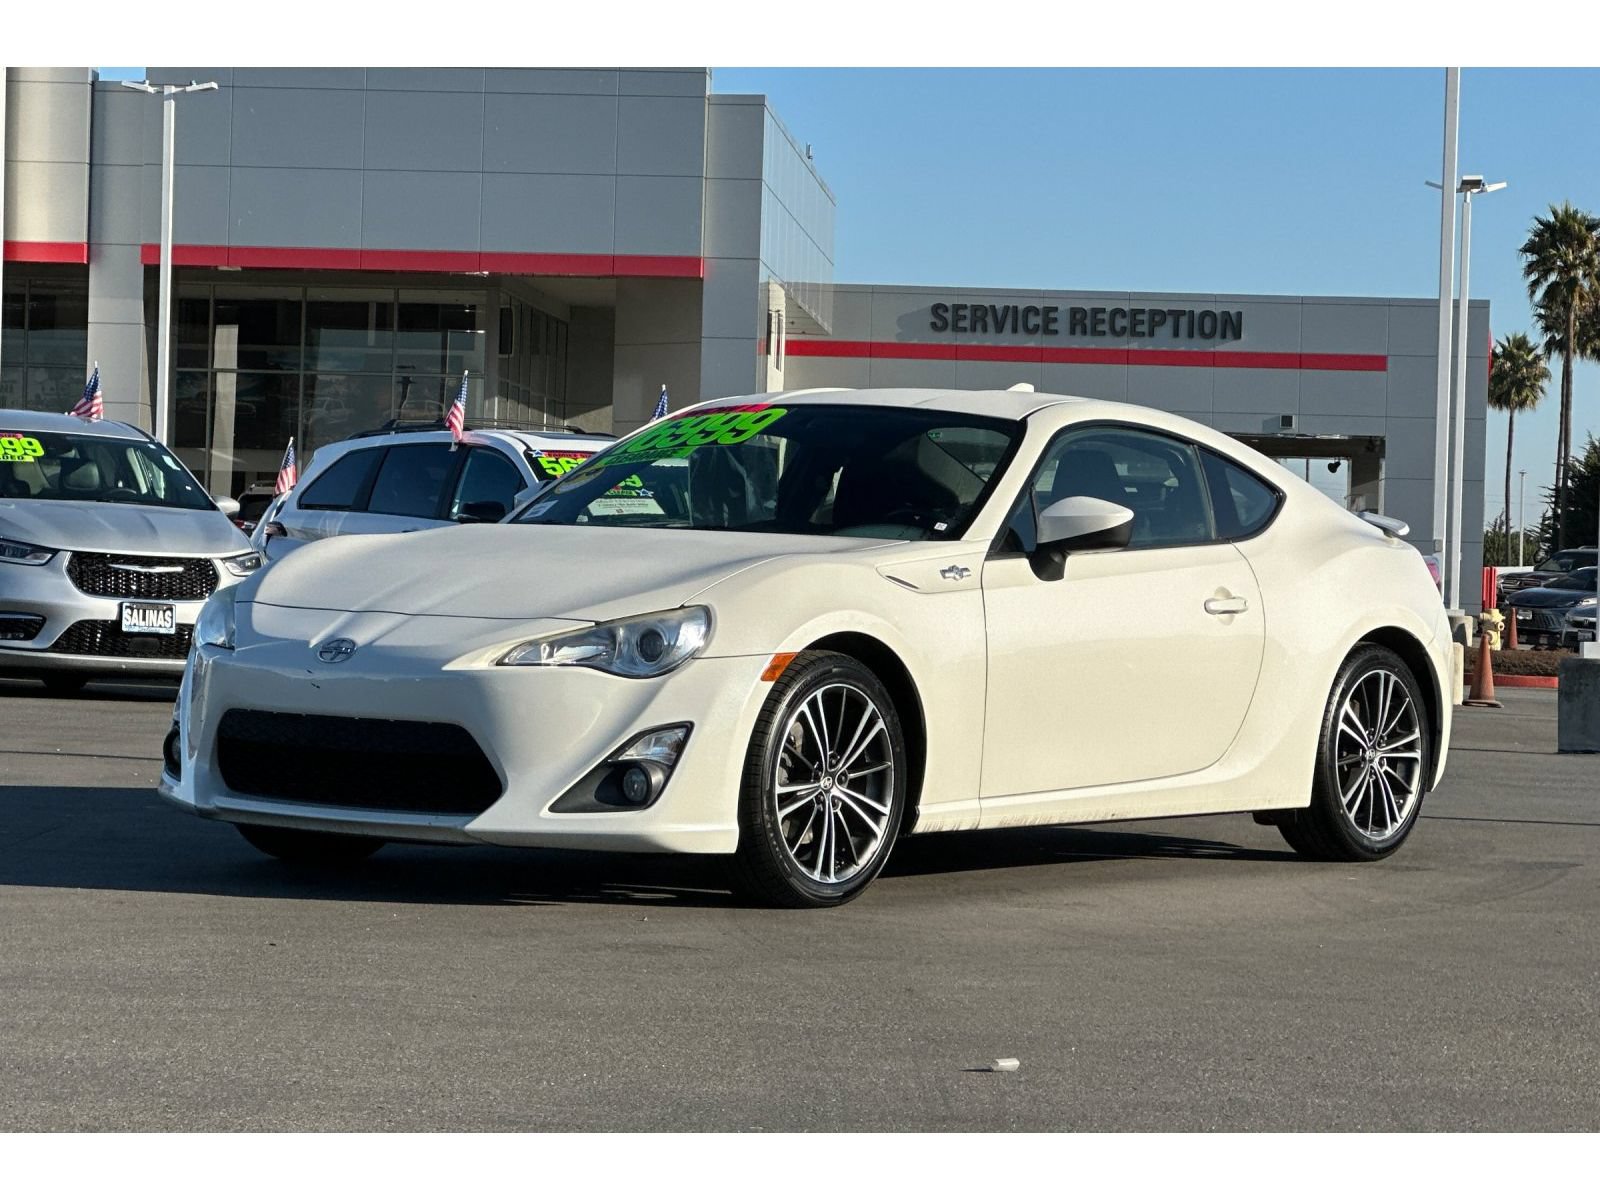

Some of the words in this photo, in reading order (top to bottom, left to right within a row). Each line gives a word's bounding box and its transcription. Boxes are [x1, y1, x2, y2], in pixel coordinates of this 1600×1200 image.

[930, 302, 1059, 335] SERVICE
[1069, 306, 1243, 340] RECEPTION
[0, 437, 45, 457] 99
[124, 608, 172, 628] SALINAS
